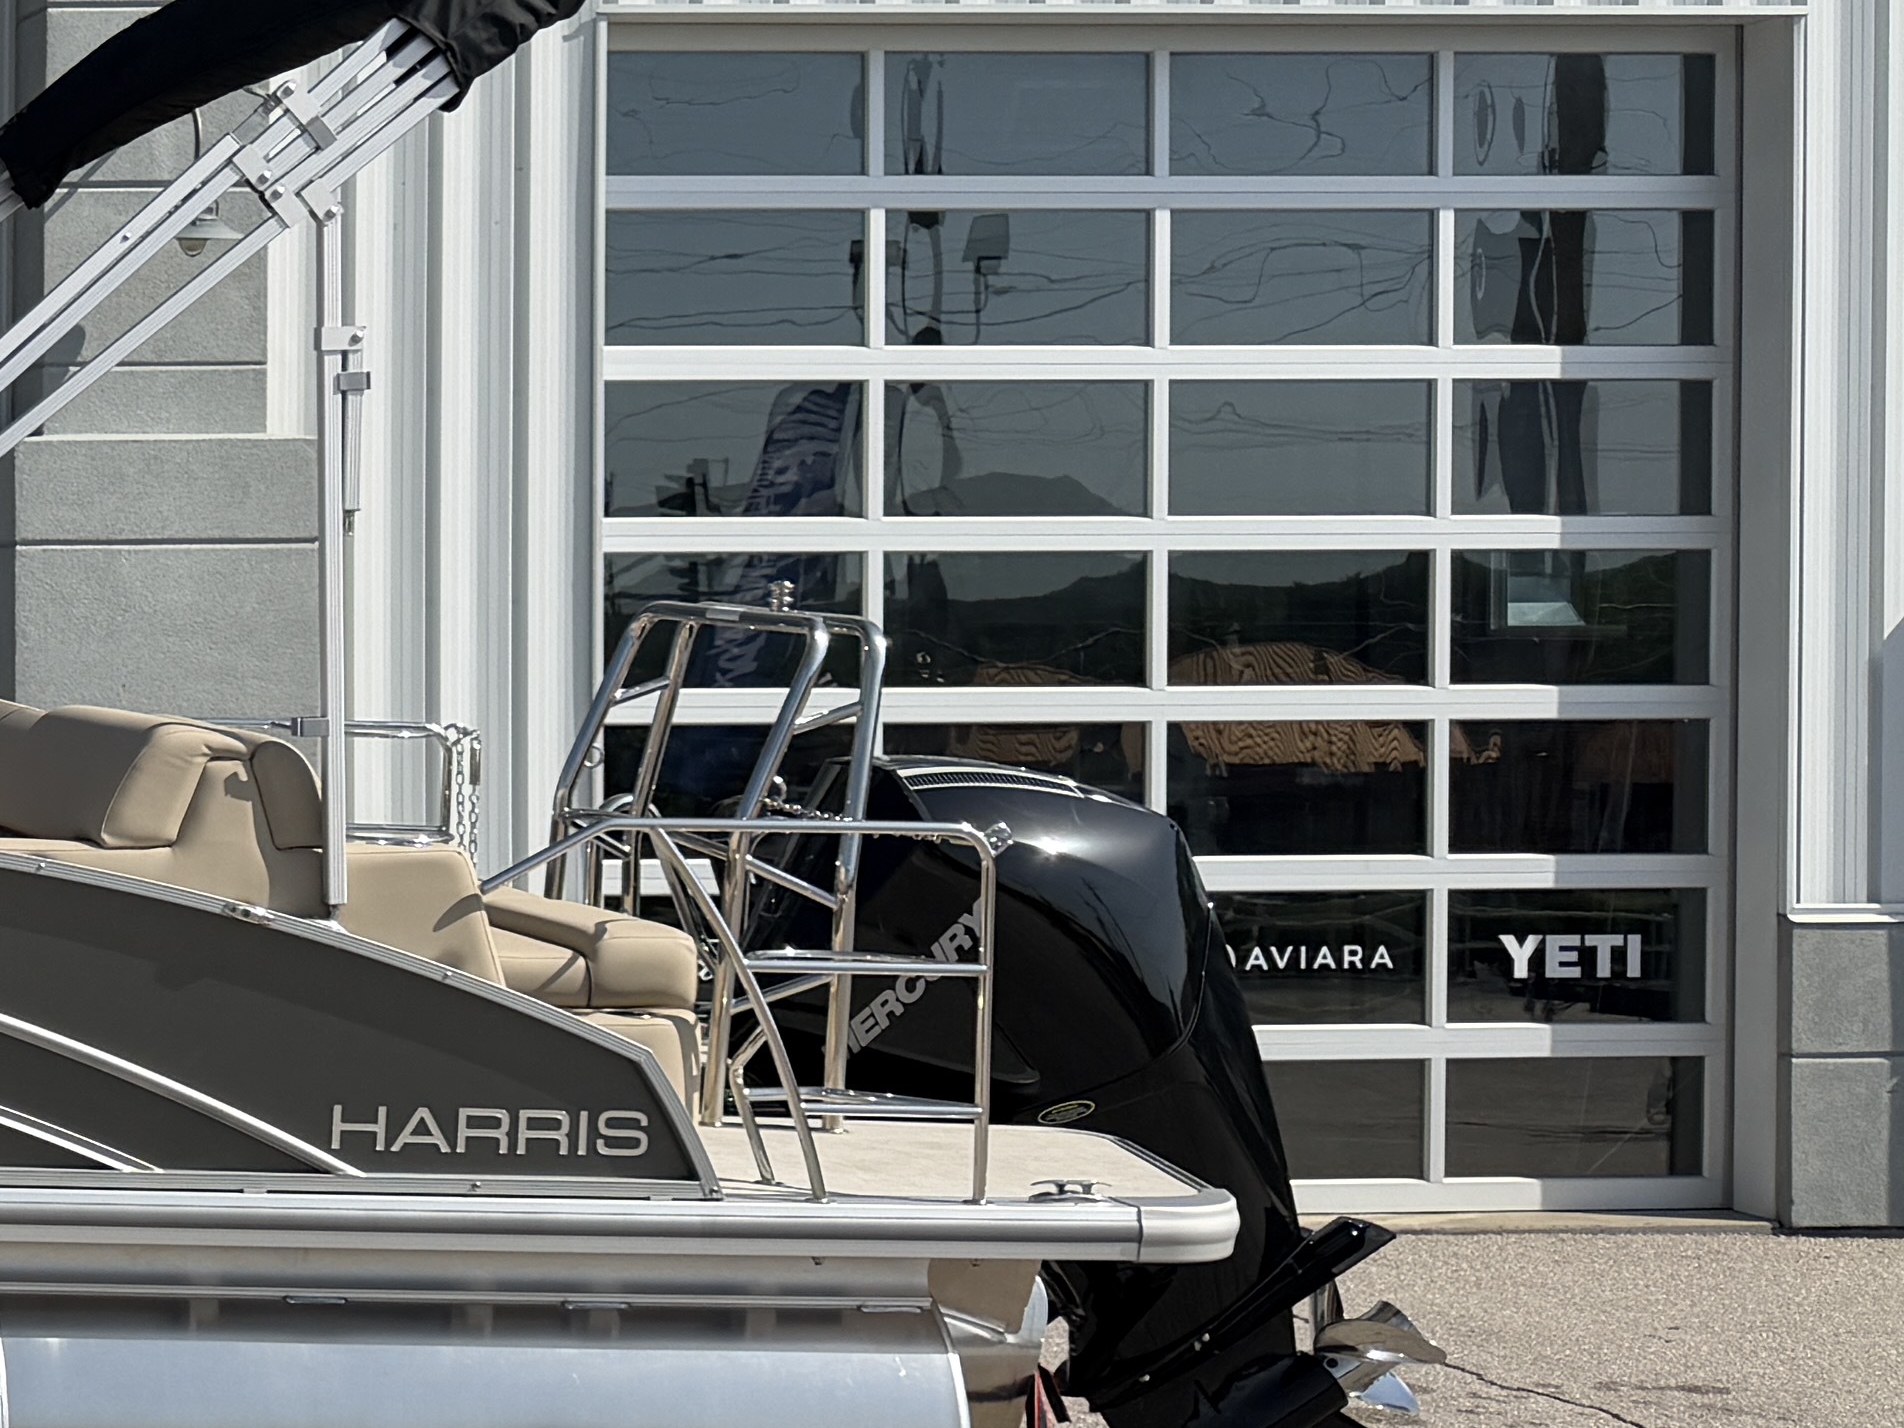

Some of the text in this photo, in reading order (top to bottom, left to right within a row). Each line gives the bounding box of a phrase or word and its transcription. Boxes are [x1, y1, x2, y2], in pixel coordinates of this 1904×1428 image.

[821, 897, 982, 1060] ERCRY
[1498, 934, 1642, 979] YETI
[330, 1103, 650, 1157] HARRIS
